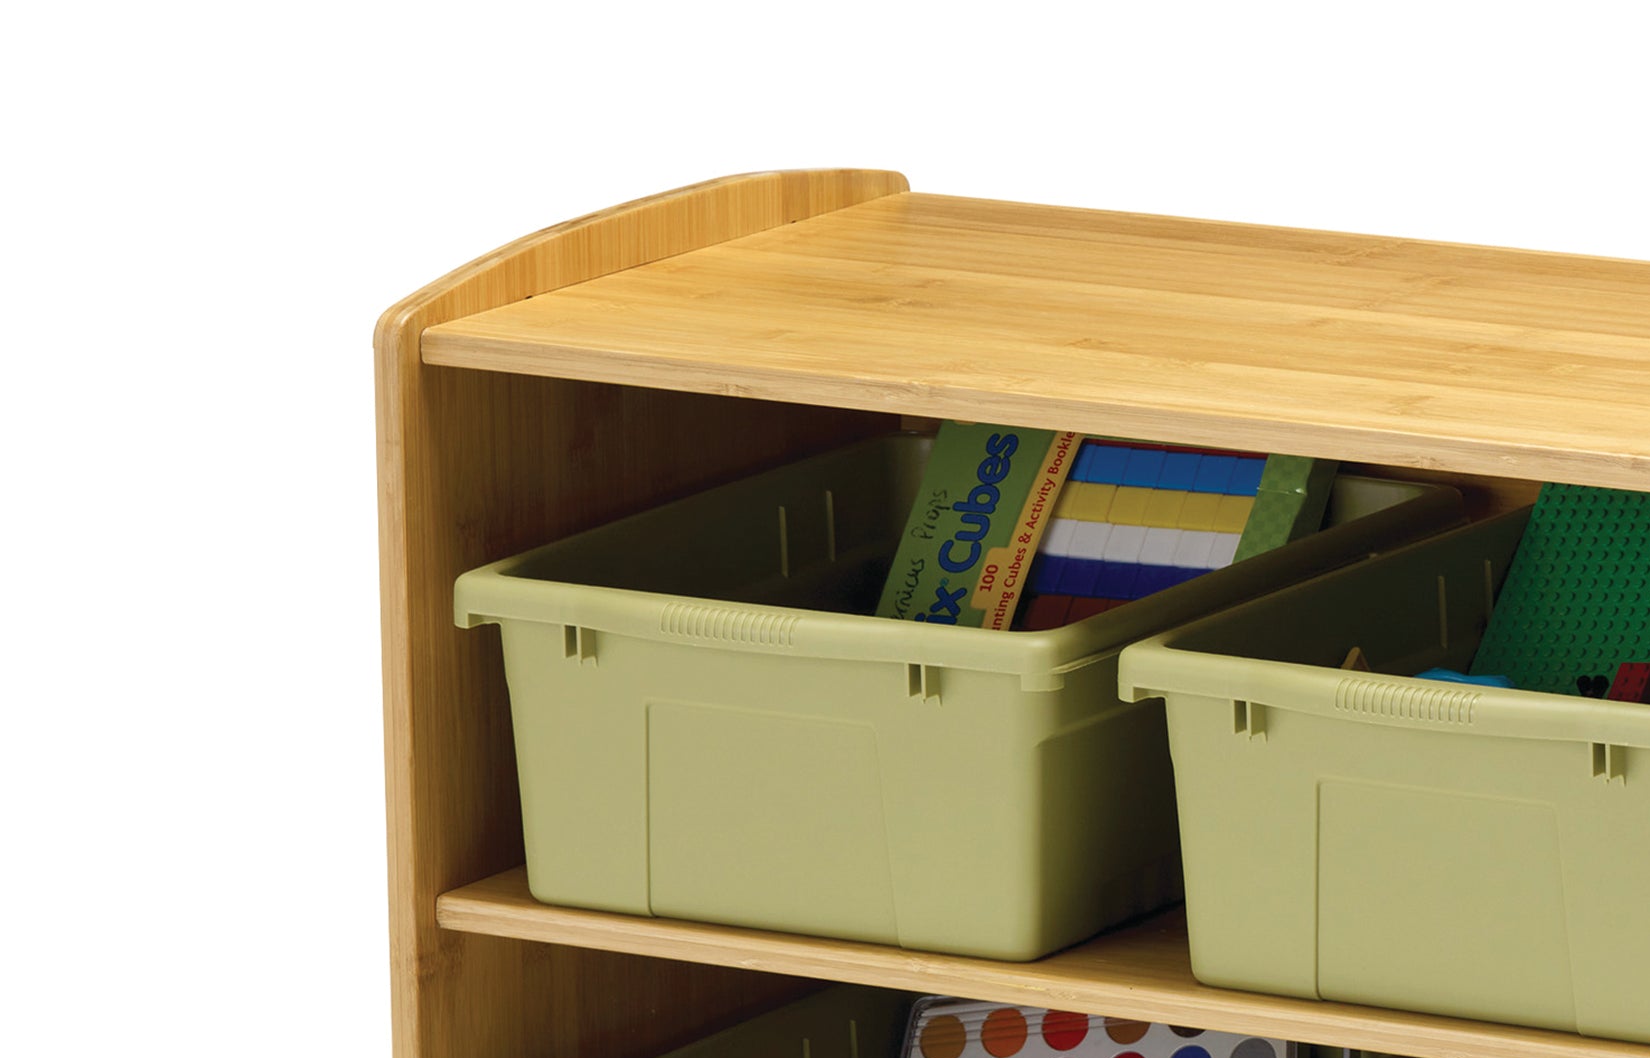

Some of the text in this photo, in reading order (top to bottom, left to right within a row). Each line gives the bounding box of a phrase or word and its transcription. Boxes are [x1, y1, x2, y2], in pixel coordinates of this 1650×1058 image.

[938, 433, 1019, 573] Cubes
[1025, 478, 1056, 530] Activity
[1018, 532, 1033, 544] &
[980, 564, 999, 592] 100
[1004, 547, 1027, 588] Cubes
